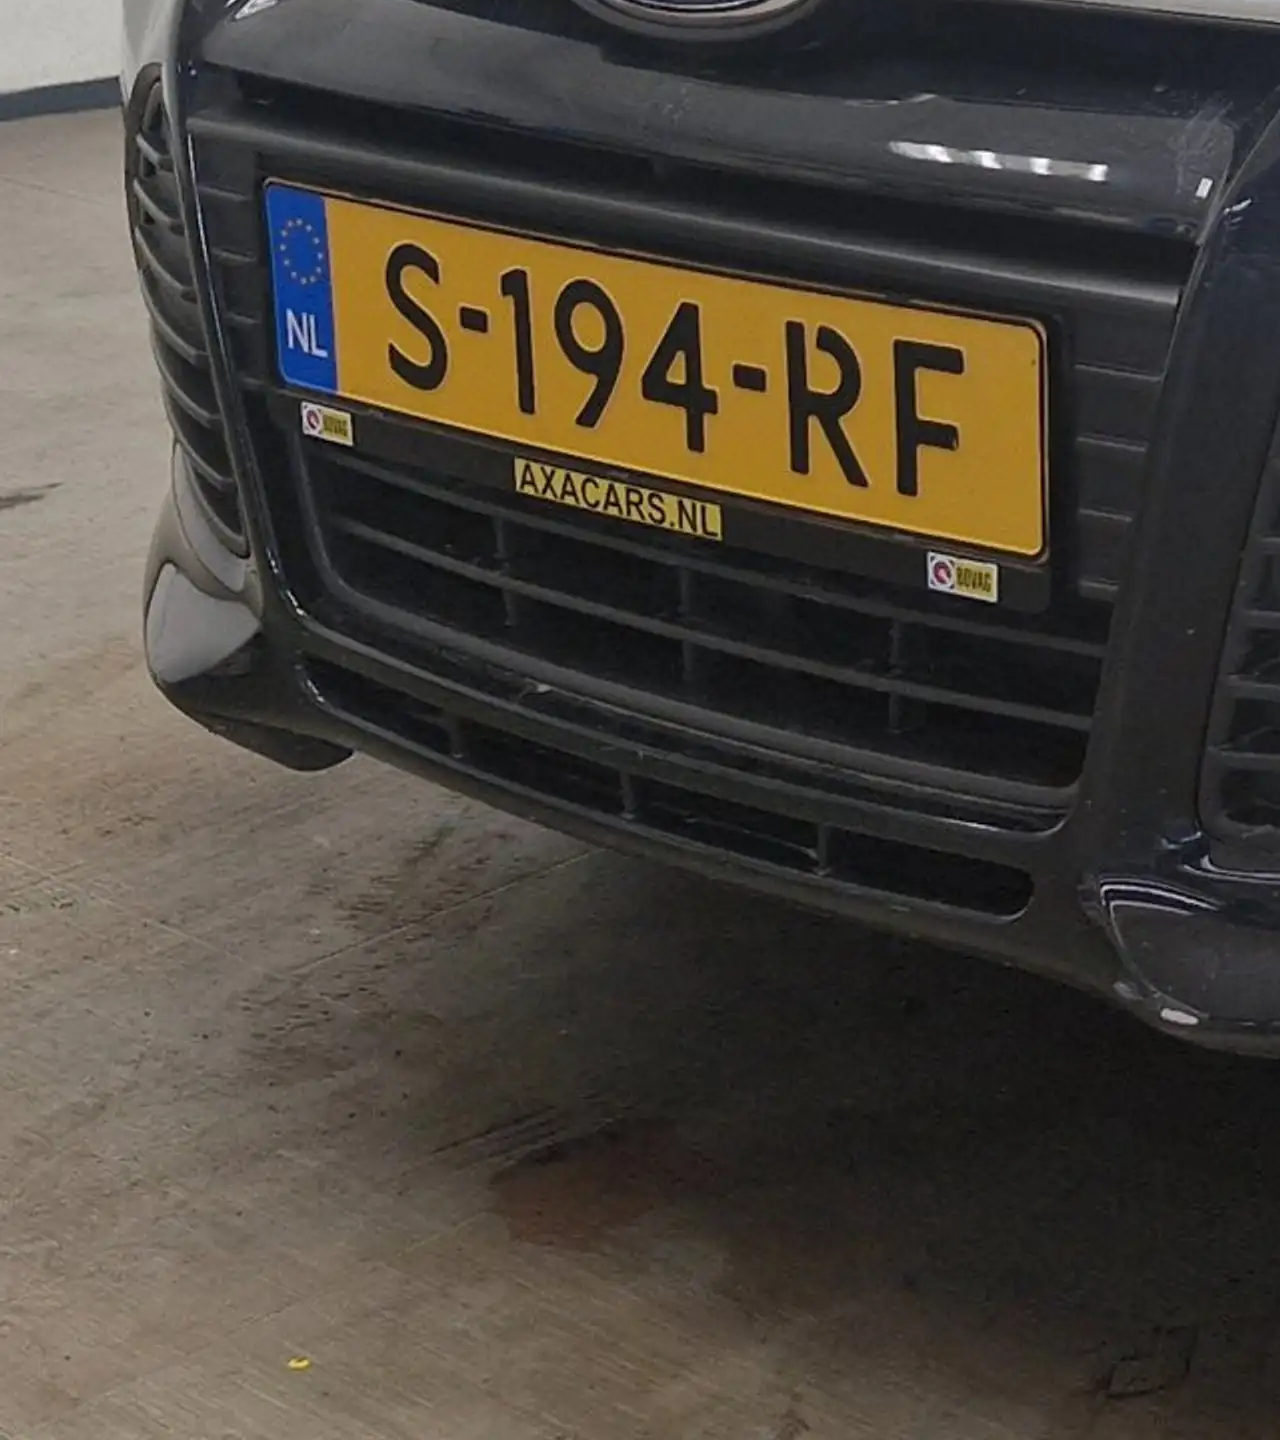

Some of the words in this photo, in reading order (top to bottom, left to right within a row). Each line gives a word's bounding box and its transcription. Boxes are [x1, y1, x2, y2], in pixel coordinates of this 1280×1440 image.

[286, 307, 329, 358] NL
[385, 243, 965, 497] S-194-RF
[519, 463, 719, 537] AXACARS.NL
